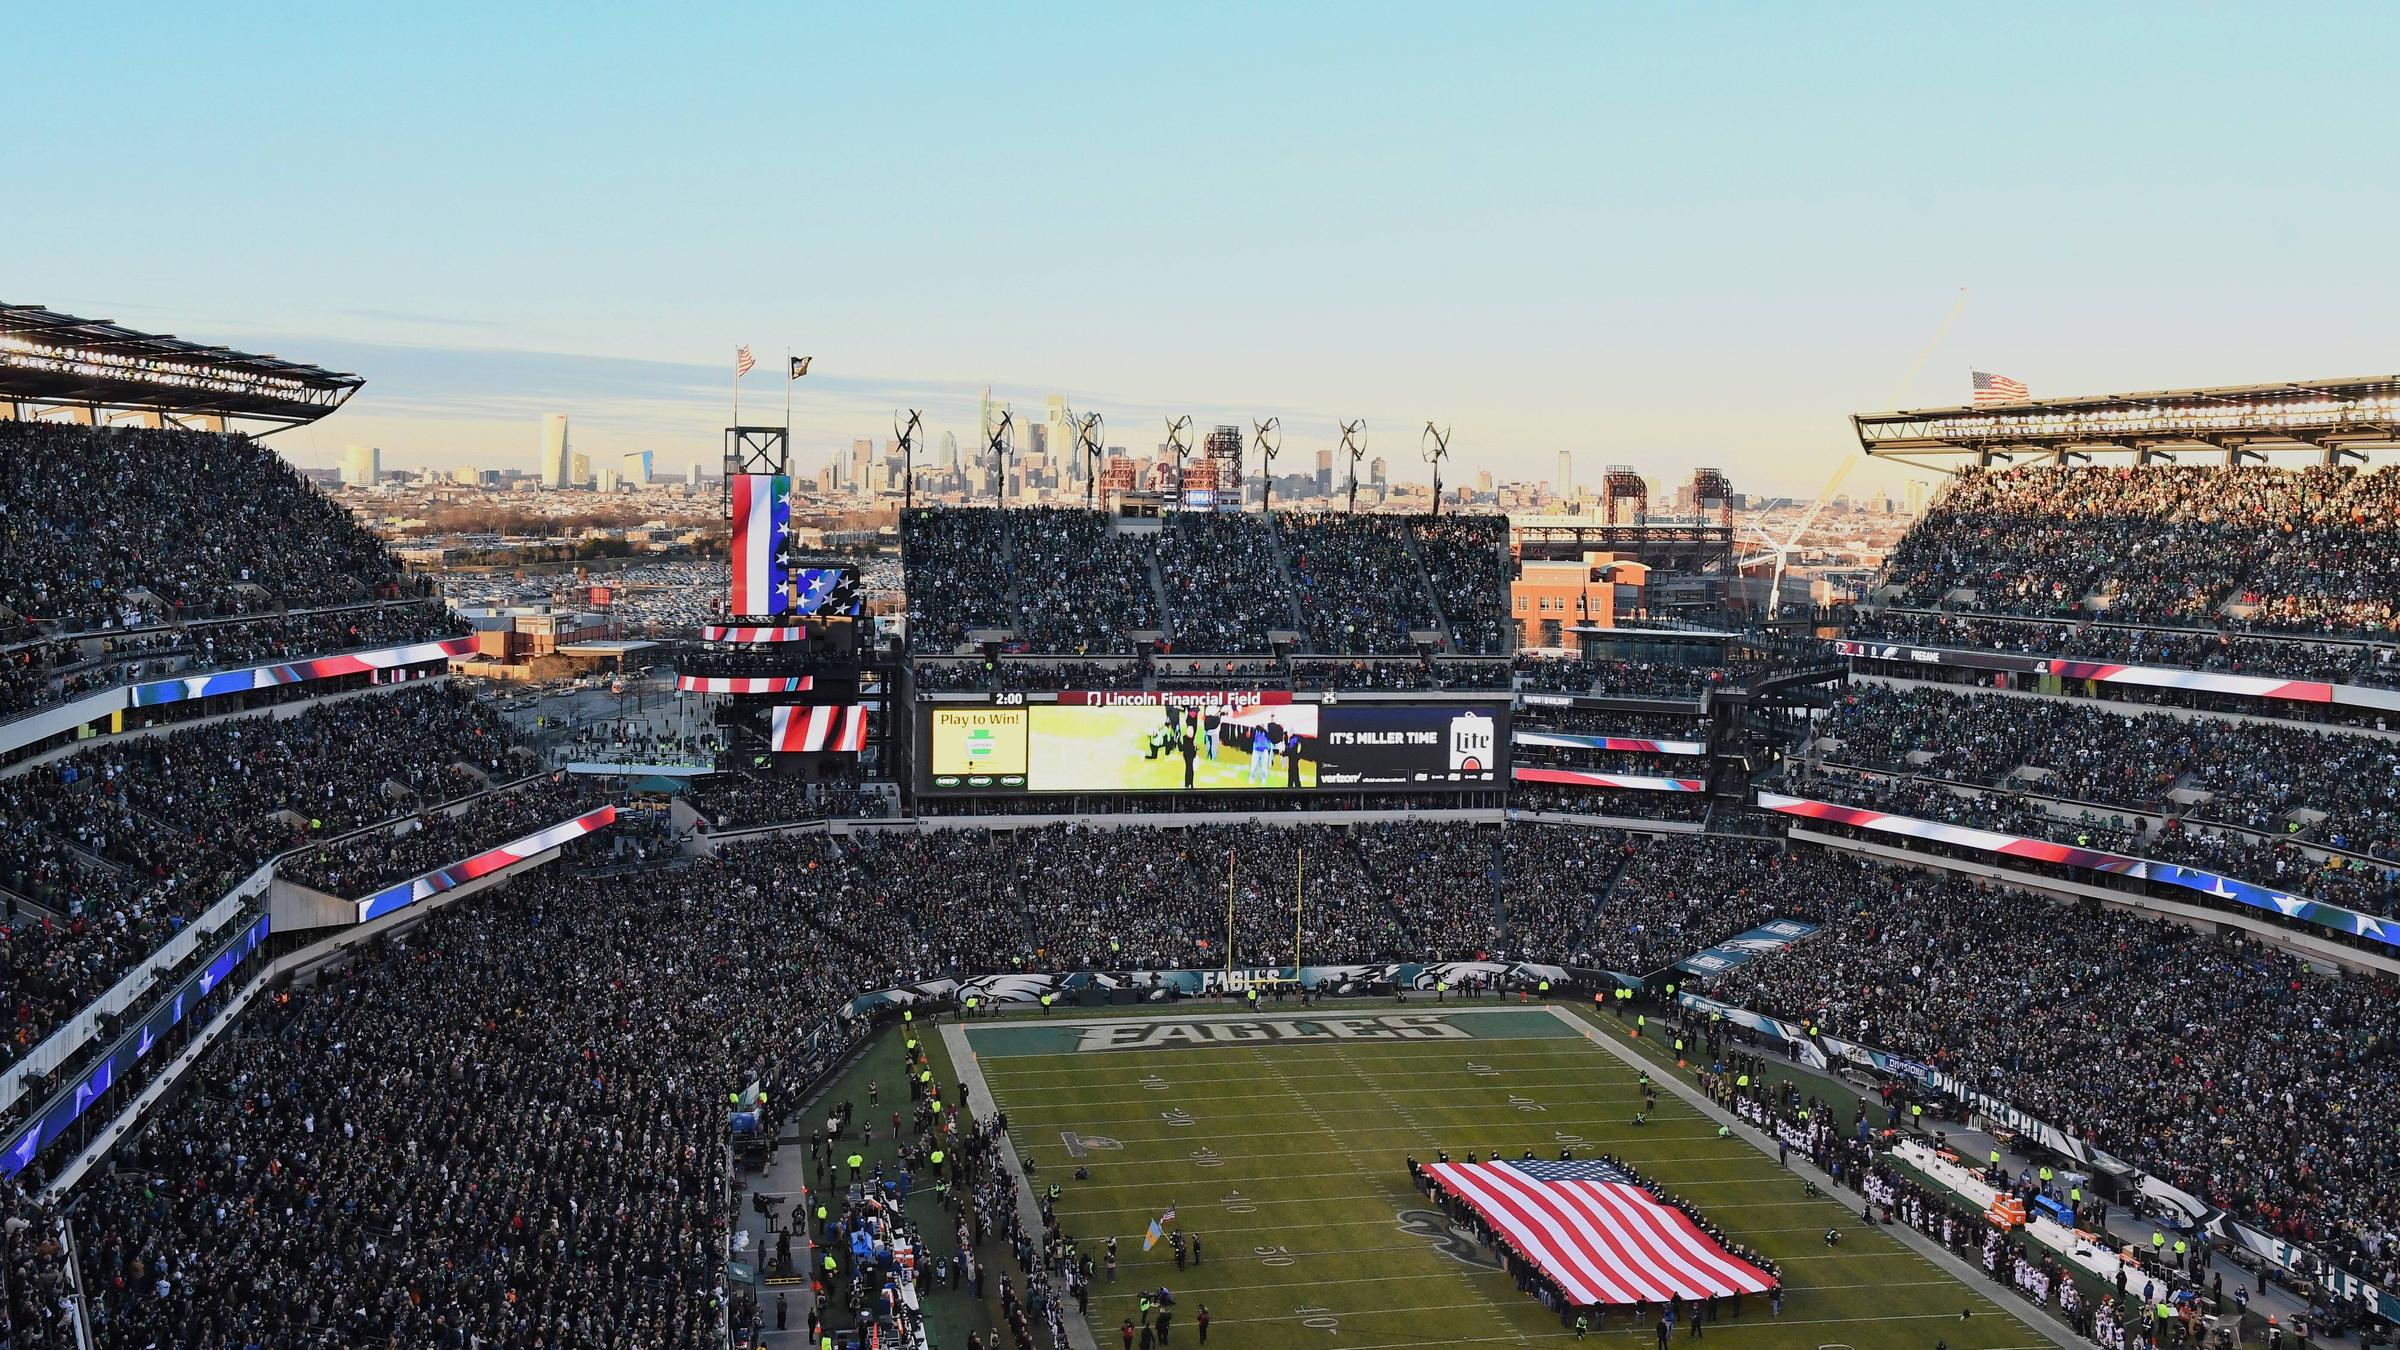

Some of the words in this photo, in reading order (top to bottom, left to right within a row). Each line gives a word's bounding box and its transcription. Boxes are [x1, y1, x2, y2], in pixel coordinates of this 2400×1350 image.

[1910, 649, 1940, 663] PREGAME
[995, 693, 1023, 705] 2:00
[1106, 692, 1156, 706] Lincoln
[1161, 692, 1223, 706] Financial
[1227, 692, 1261, 706] Field
[940, 713, 969, 728] Play
[973, 714, 986, 725] to
[989, 713, 1019, 725] Win!
[1329, 731, 1354, 745] IT'S
[1356, 731, 1405, 745] MILLER
[1406, 731, 1438, 745] TIME
[1455, 731, 1489, 754] Lite
[1321, 772, 1361, 783] verizon
[1065, 1015, 1473, 1053] EAGLES
[1161, 1111, 1195, 1126] 20
[1189, 1150, 1225, 1168] 30
[1253, 1246, 1296, 1267] 50
[1294, 1304, 1339, 1328] 40
